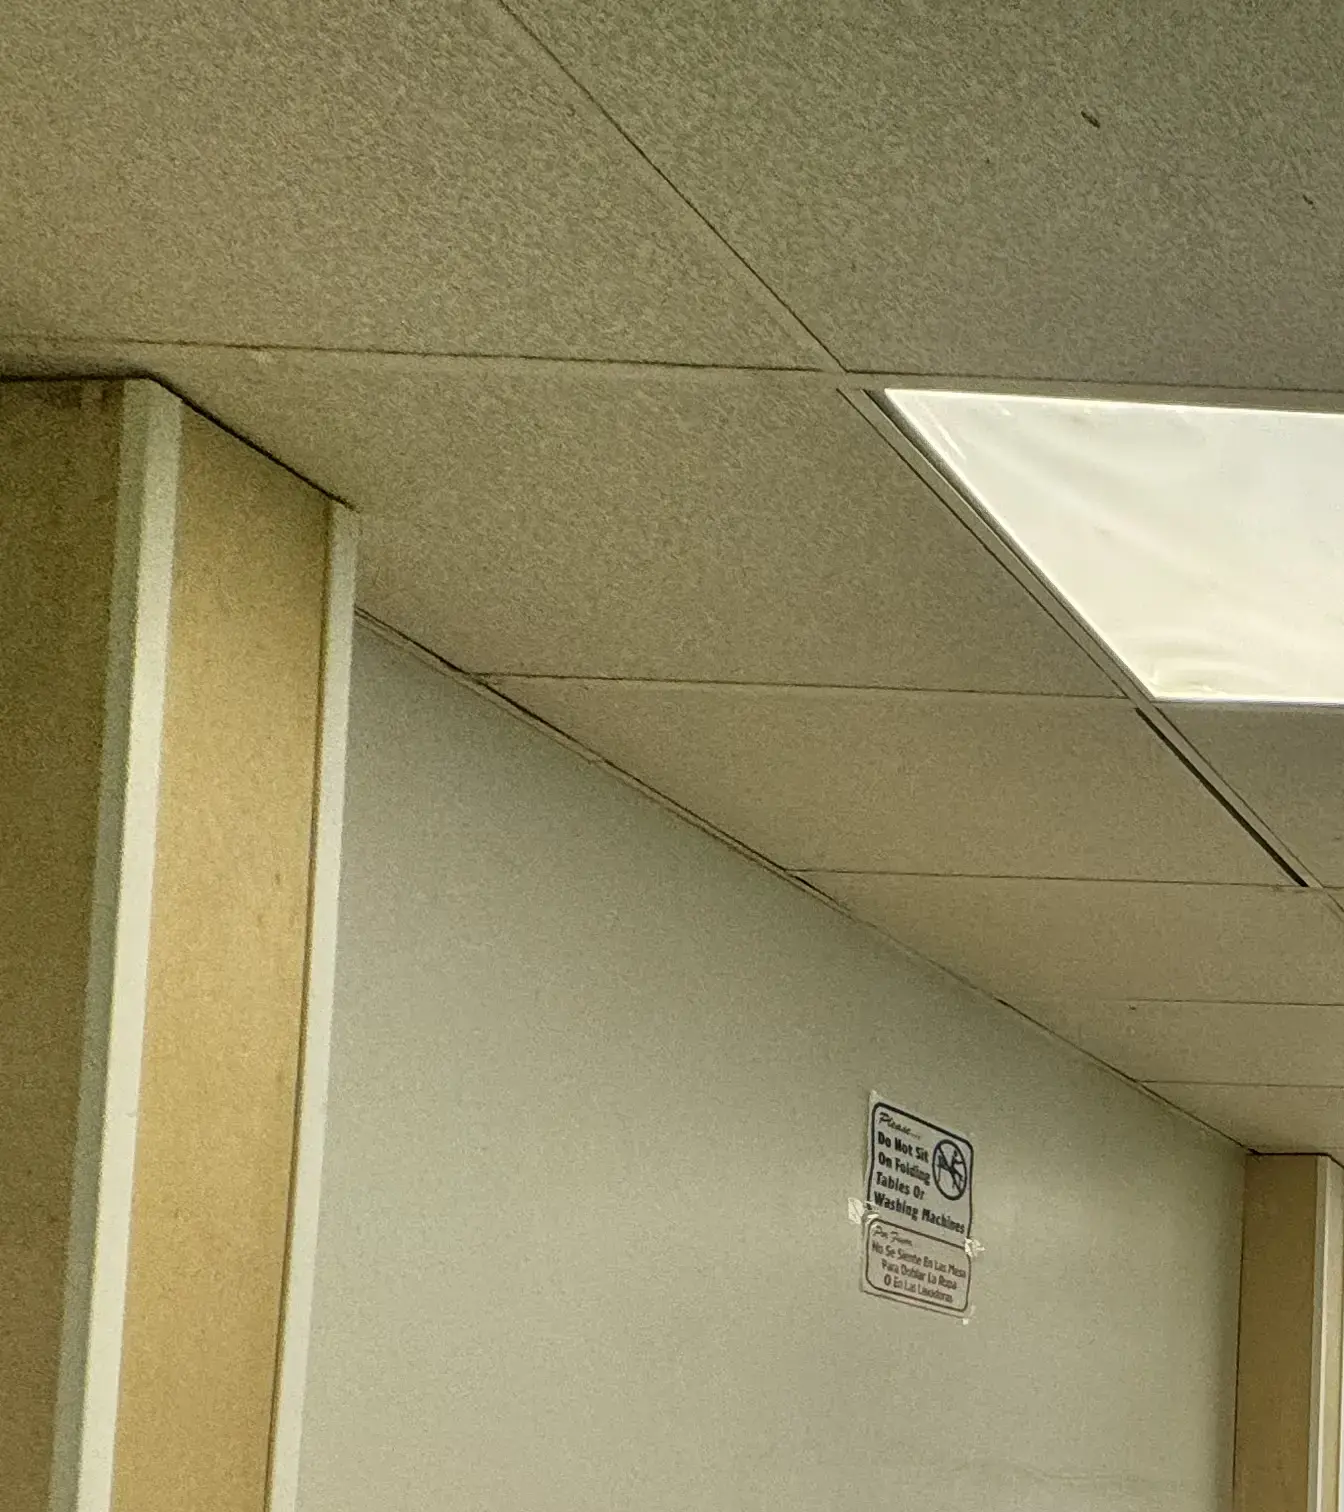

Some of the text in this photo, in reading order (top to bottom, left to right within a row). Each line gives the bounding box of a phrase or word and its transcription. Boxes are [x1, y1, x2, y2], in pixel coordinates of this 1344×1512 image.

[878, 1131, 929, 1163] Do Not Sit
[878, 1152, 892, 1168] On
[876, 1172, 925, 1200] Tables Or
[874, 1191, 965, 1234] Washing Machines
